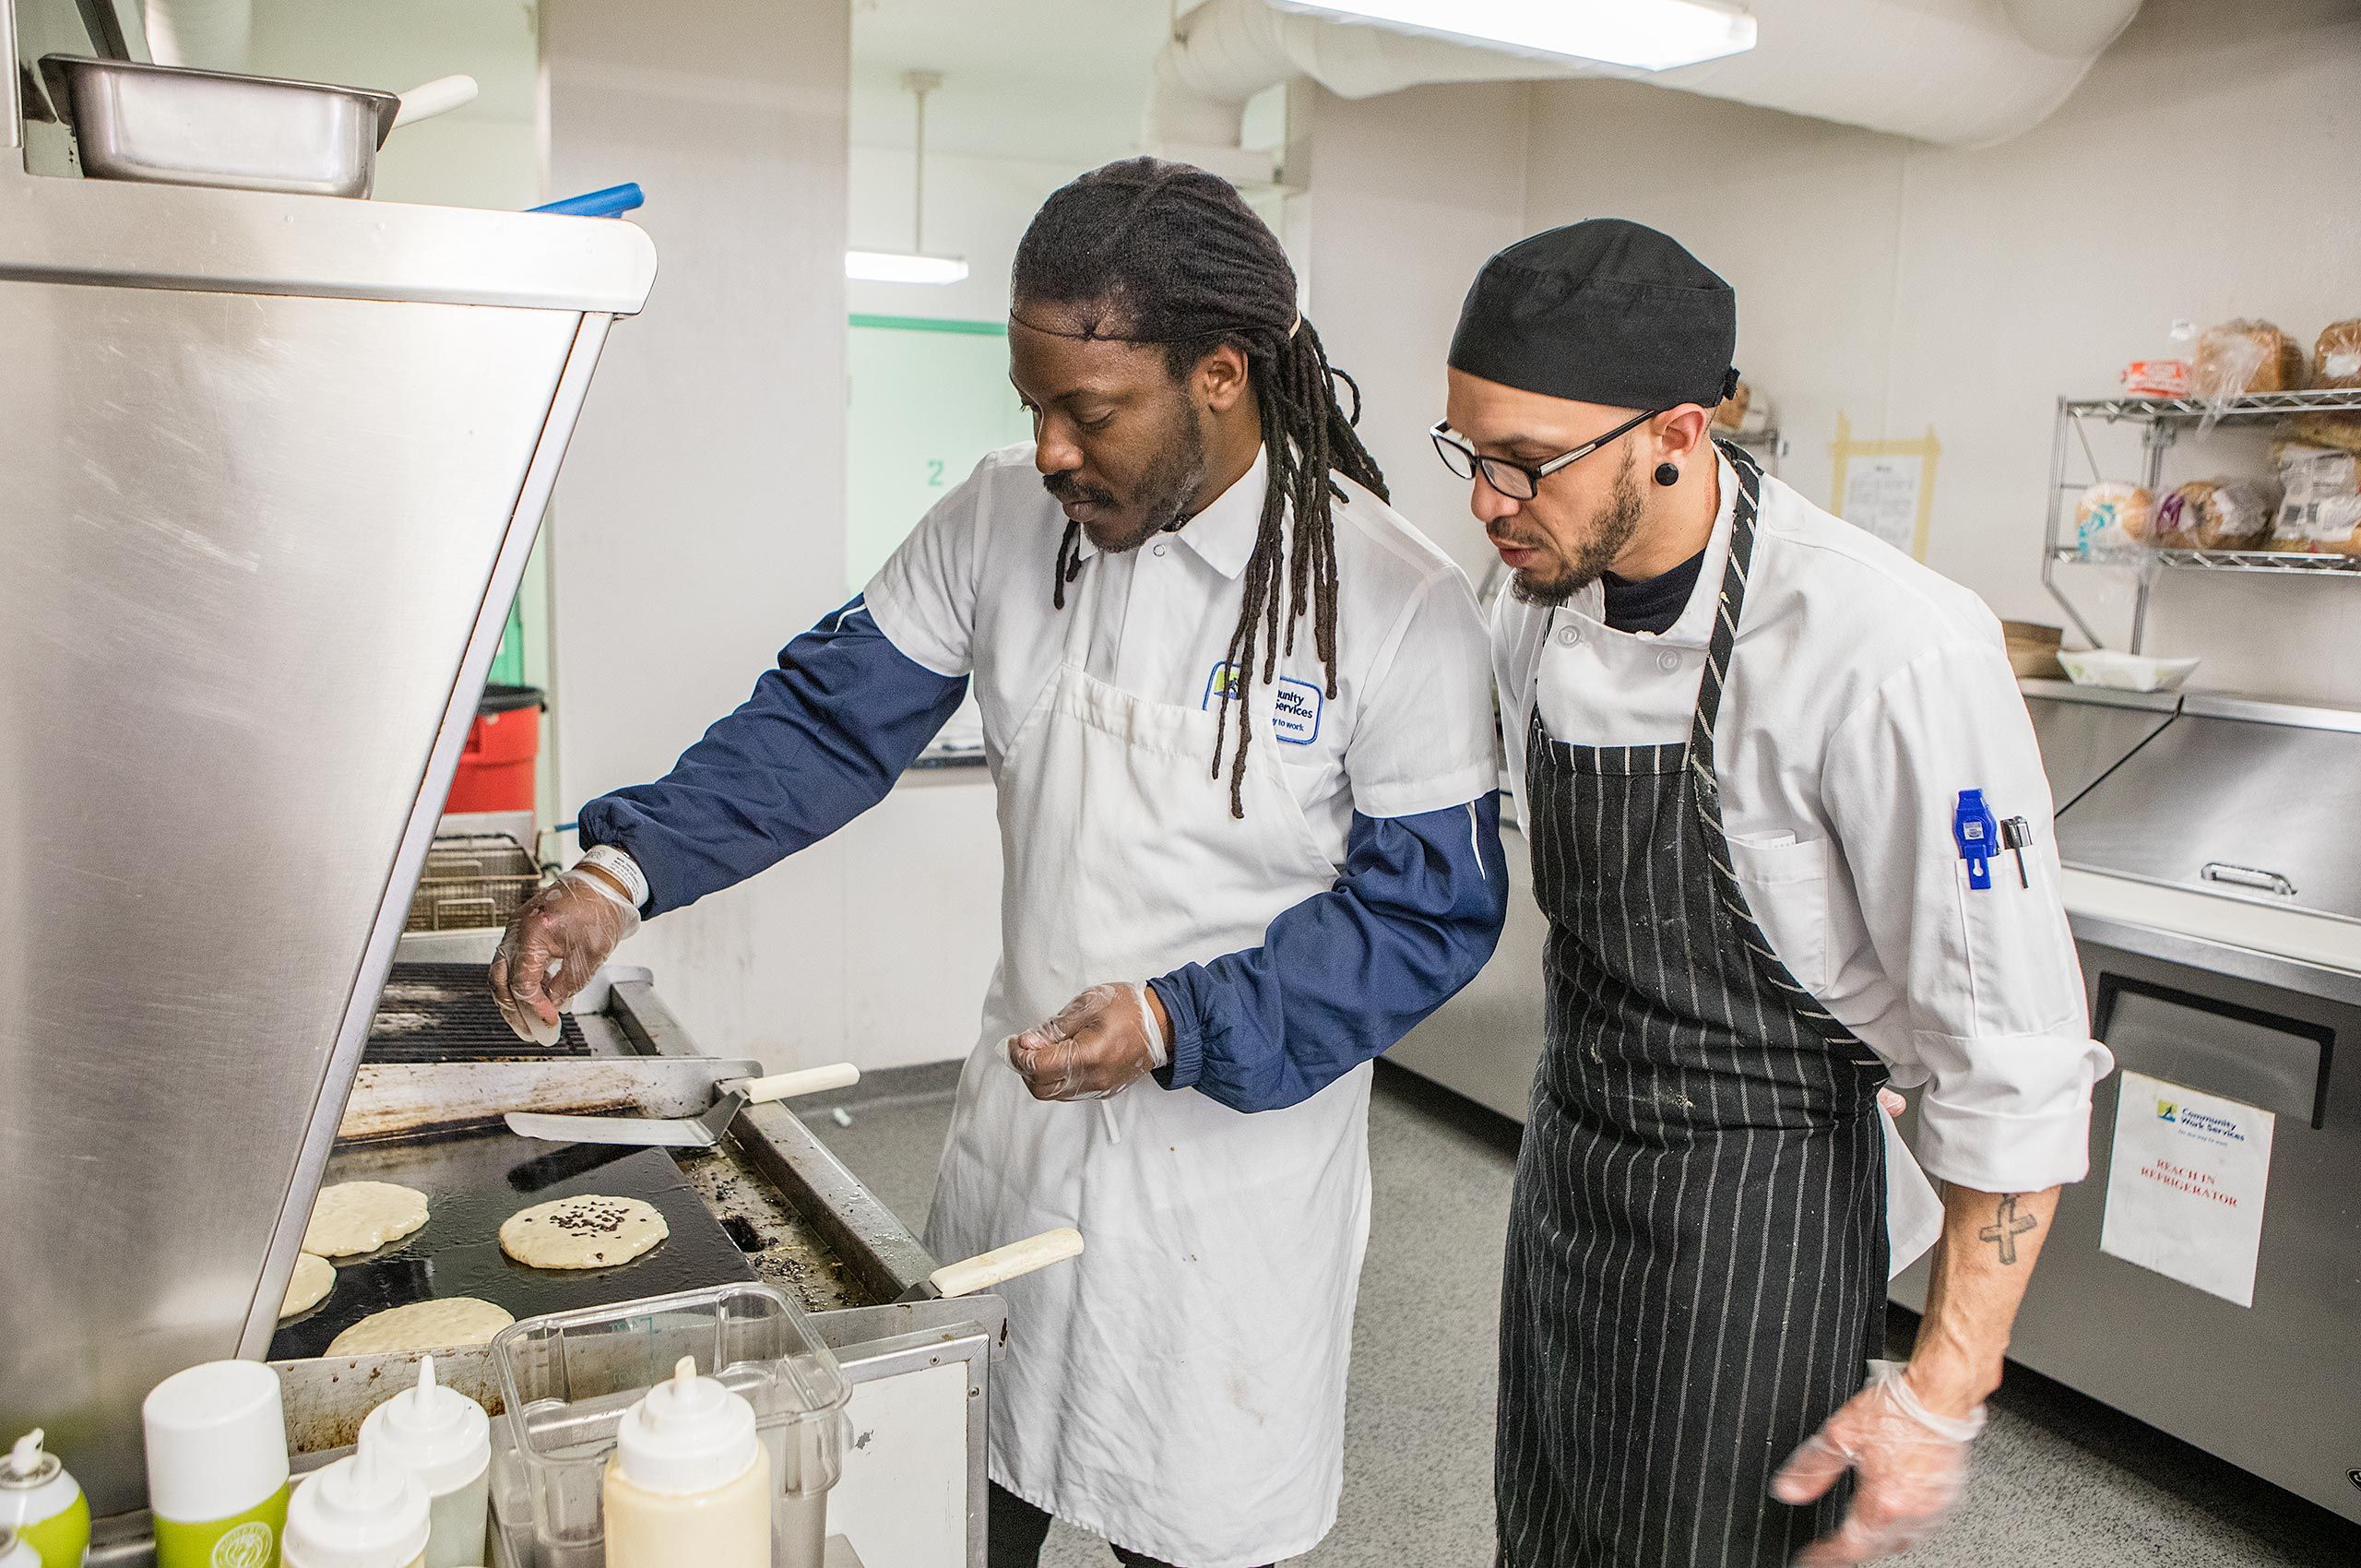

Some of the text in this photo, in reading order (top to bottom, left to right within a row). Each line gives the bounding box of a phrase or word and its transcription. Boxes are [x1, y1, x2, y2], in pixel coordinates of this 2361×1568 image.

[928, 458, 943, 486] 2
[1278, 690, 1304, 707] unity
[1286, 720, 1305, 731] work
[2181, 1117, 2245, 1141] Work Services
[2182, 1108, 2236, 1131] Community
[2156, 1159, 2215, 1185] REACH IN
[2140, 1166, 2237, 1206] REFRIGERATOR
